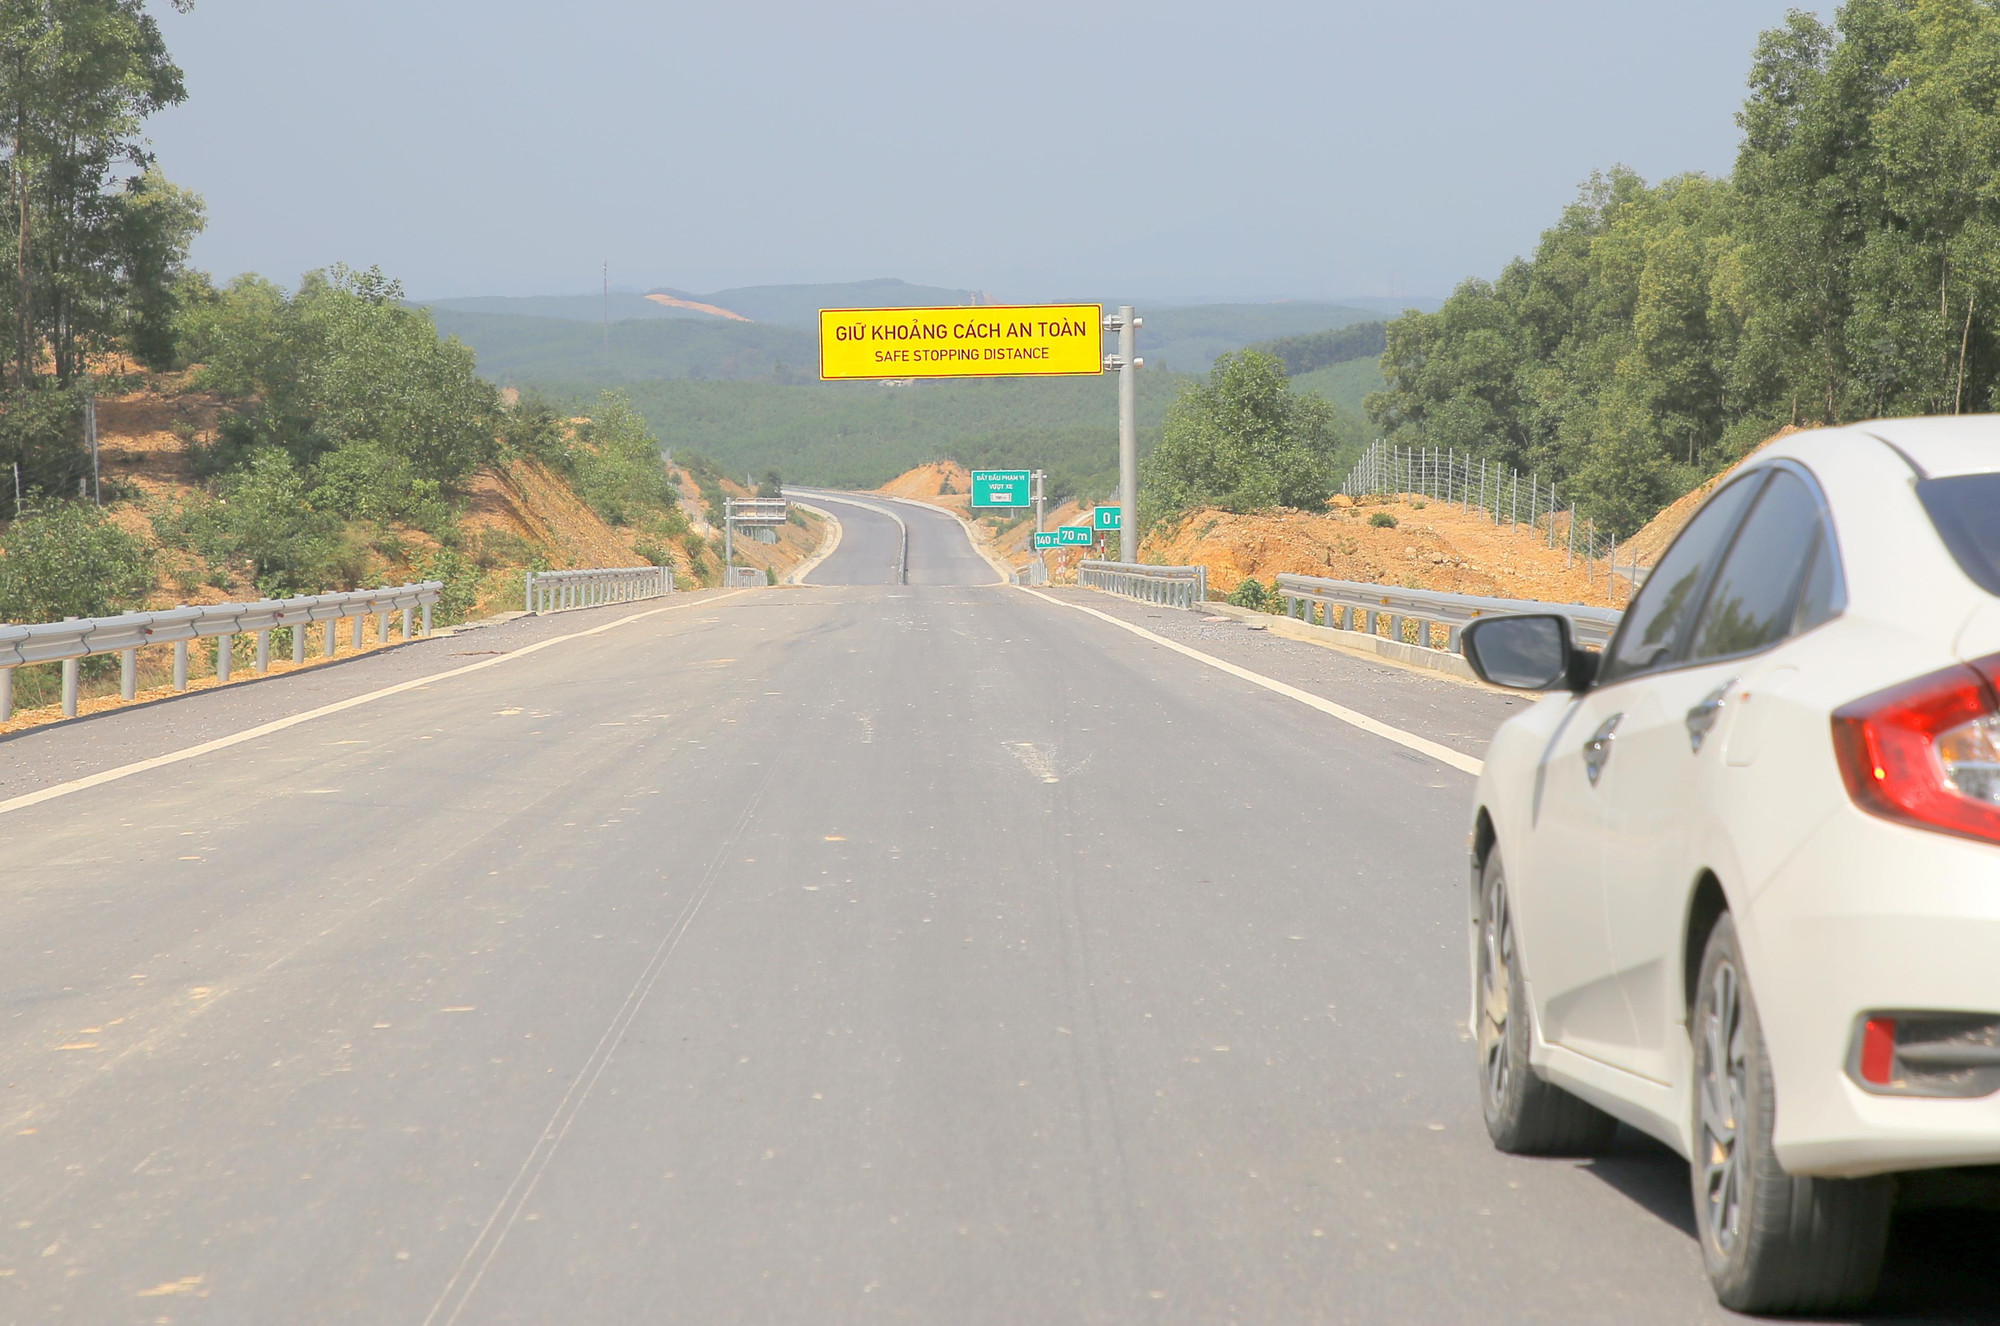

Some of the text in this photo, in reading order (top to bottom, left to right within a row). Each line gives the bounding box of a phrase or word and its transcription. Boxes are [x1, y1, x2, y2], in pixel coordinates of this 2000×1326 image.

[836, 317, 1086, 341] GIỮ KHOẢNG CÁCH AN TOÀN
[875, 347, 1050, 363] SAFE STOPPING DISTANCE
[1103, 512, 1111, 525] 0
[1036, 535, 1051, 545] 140
[1061, 530, 1075, 541] 70
[1077, 532, 1088, 541] m
